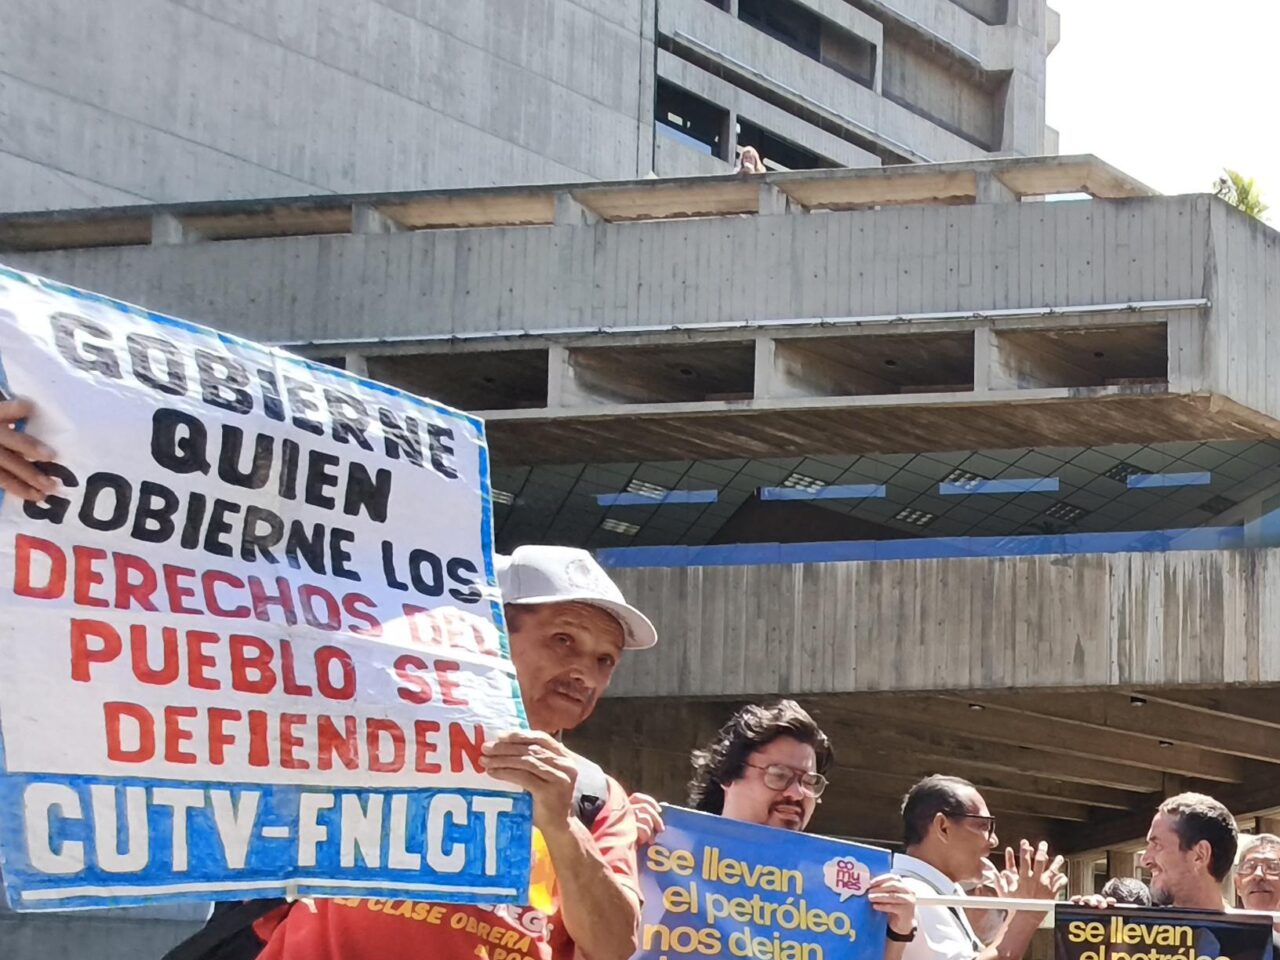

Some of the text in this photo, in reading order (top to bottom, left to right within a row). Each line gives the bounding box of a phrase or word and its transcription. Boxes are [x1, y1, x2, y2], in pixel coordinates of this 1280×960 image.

[49, 311, 458, 480] GOBIERNE
[151, 406, 392, 523] QUIEN
[22, 461, 484, 604] GOBIERNE LOS
[13, 533, 384, 640] DERECHOS
[70, 618, 467, 707] PUEBLO SE
[103, 701, 487, 776] DEFIENDEN
[22, 781, 515, 877] CUTV-FNLCT
[646, 844, 803, 895] se llevan
[366, 898, 447, 925] CLASE
[642, 925, 721, 954] nos
[663, 881, 857, 942] el petróleo,
[1068, 916, 1193, 947] se llevan
